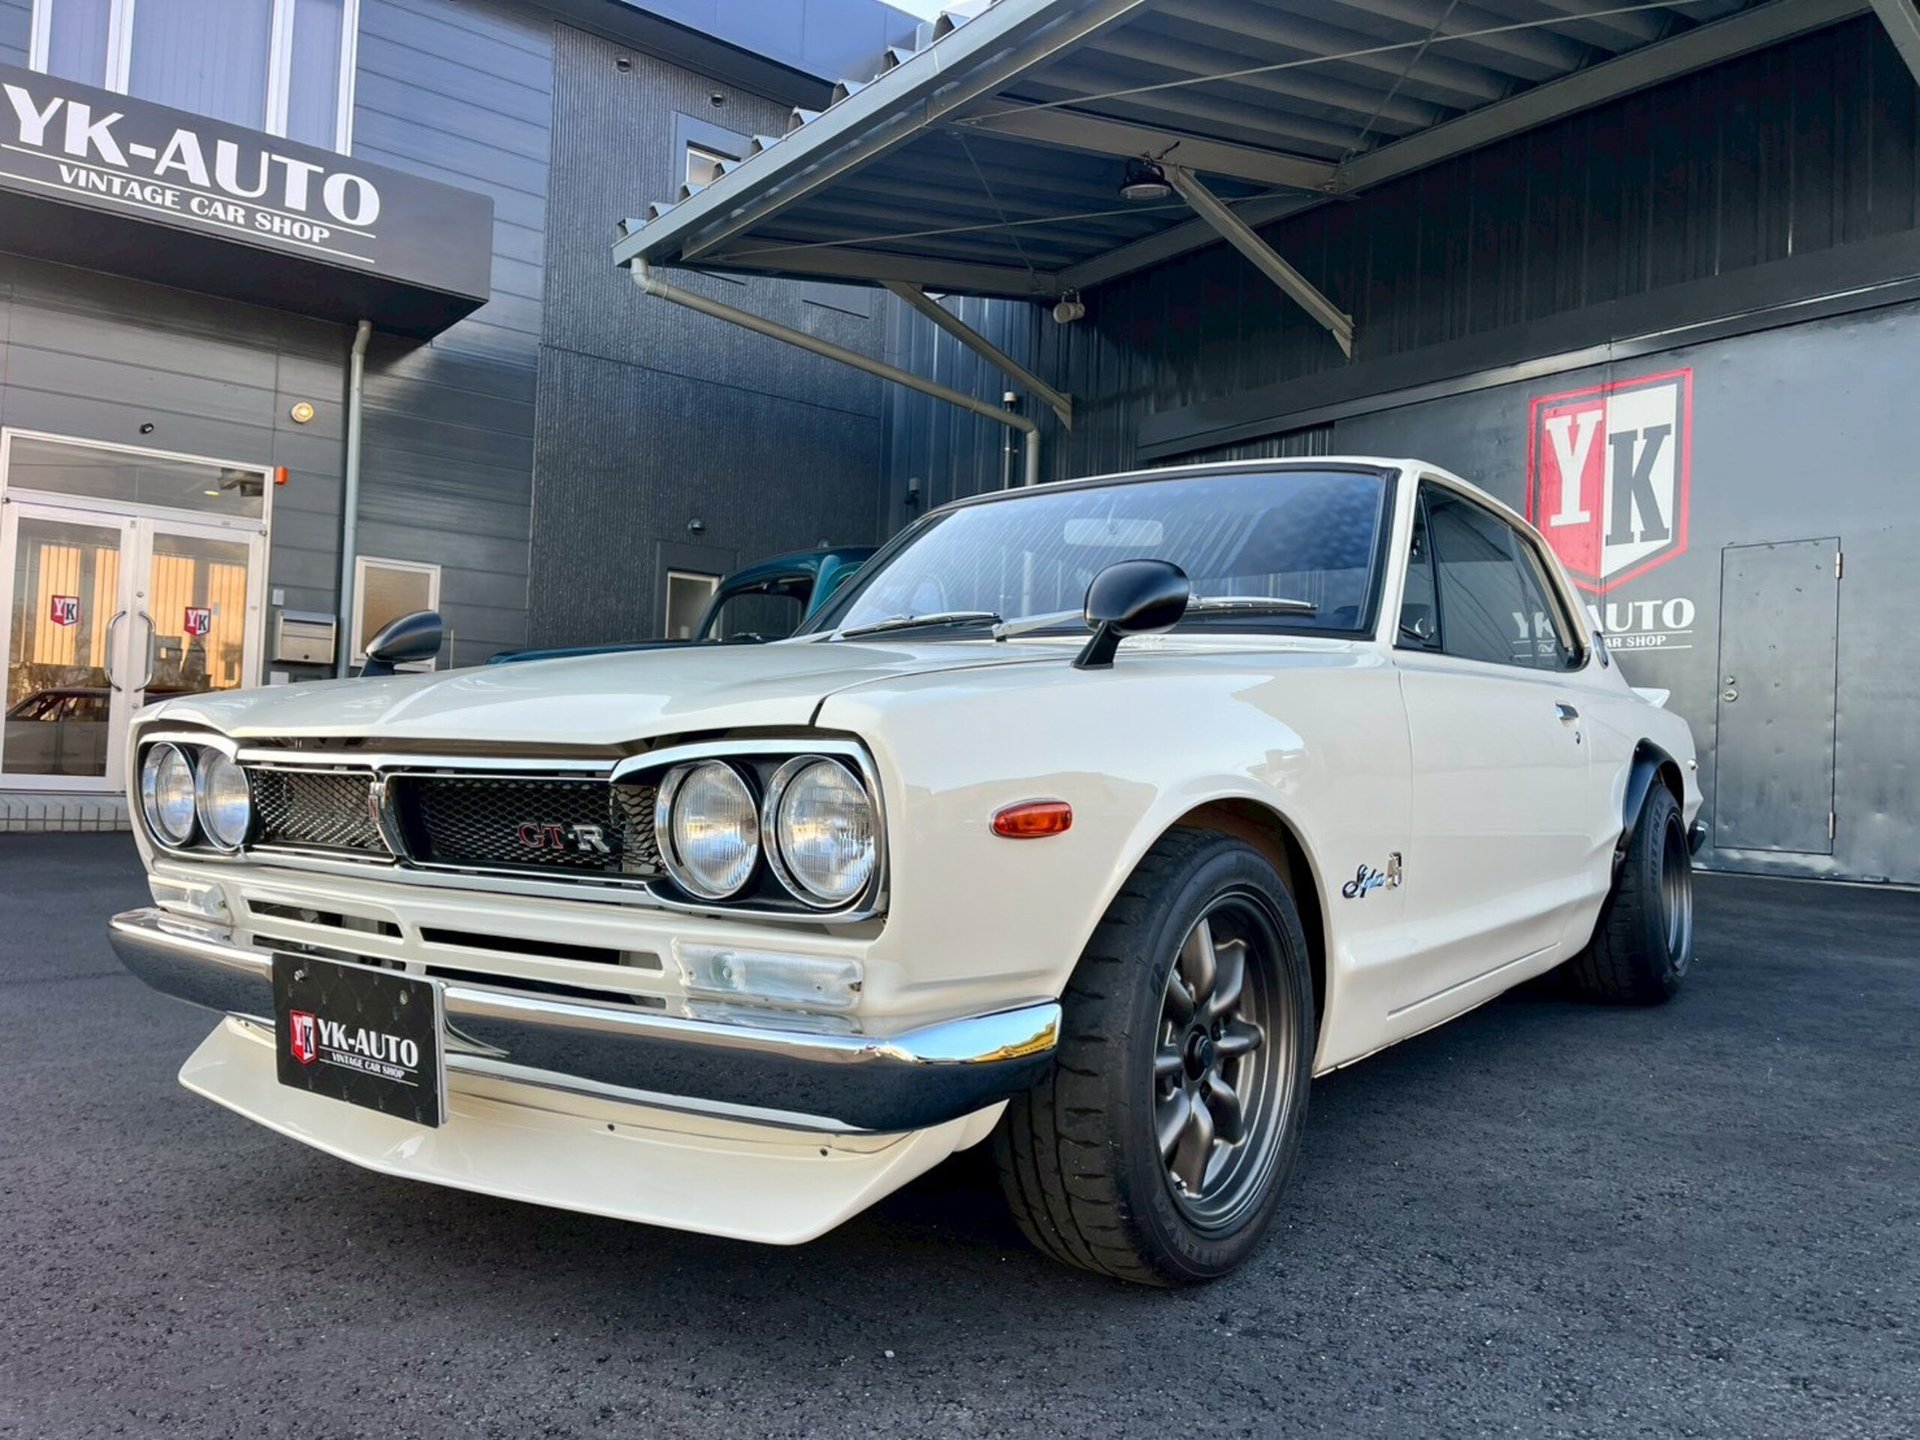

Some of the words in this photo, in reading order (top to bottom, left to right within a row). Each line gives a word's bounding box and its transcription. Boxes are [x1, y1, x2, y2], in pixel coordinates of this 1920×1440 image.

[2, 82, 381, 227] YK-AUTO
[59, 164, 181, 209] VINTAGE
[190, 196, 245, 226] CAR
[254, 212, 330, 244] SHOP
[1545, 409, 1672, 547] YK
[54, 598, 76, 621] YK
[187, 609, 208, 632] YK
[1626, 635, 1667, 647] SHOP
[518, 822, 611, 853] GT-R
[291, 1014, 314, 1055] YK
[316, 1018, 419, 1068] YK-AUTO
[331, 1052, 364, 1069] VINTAGE
[364, 1061, 381, 1073] CAR
[381, 1065, 405, 1079] SHOP
